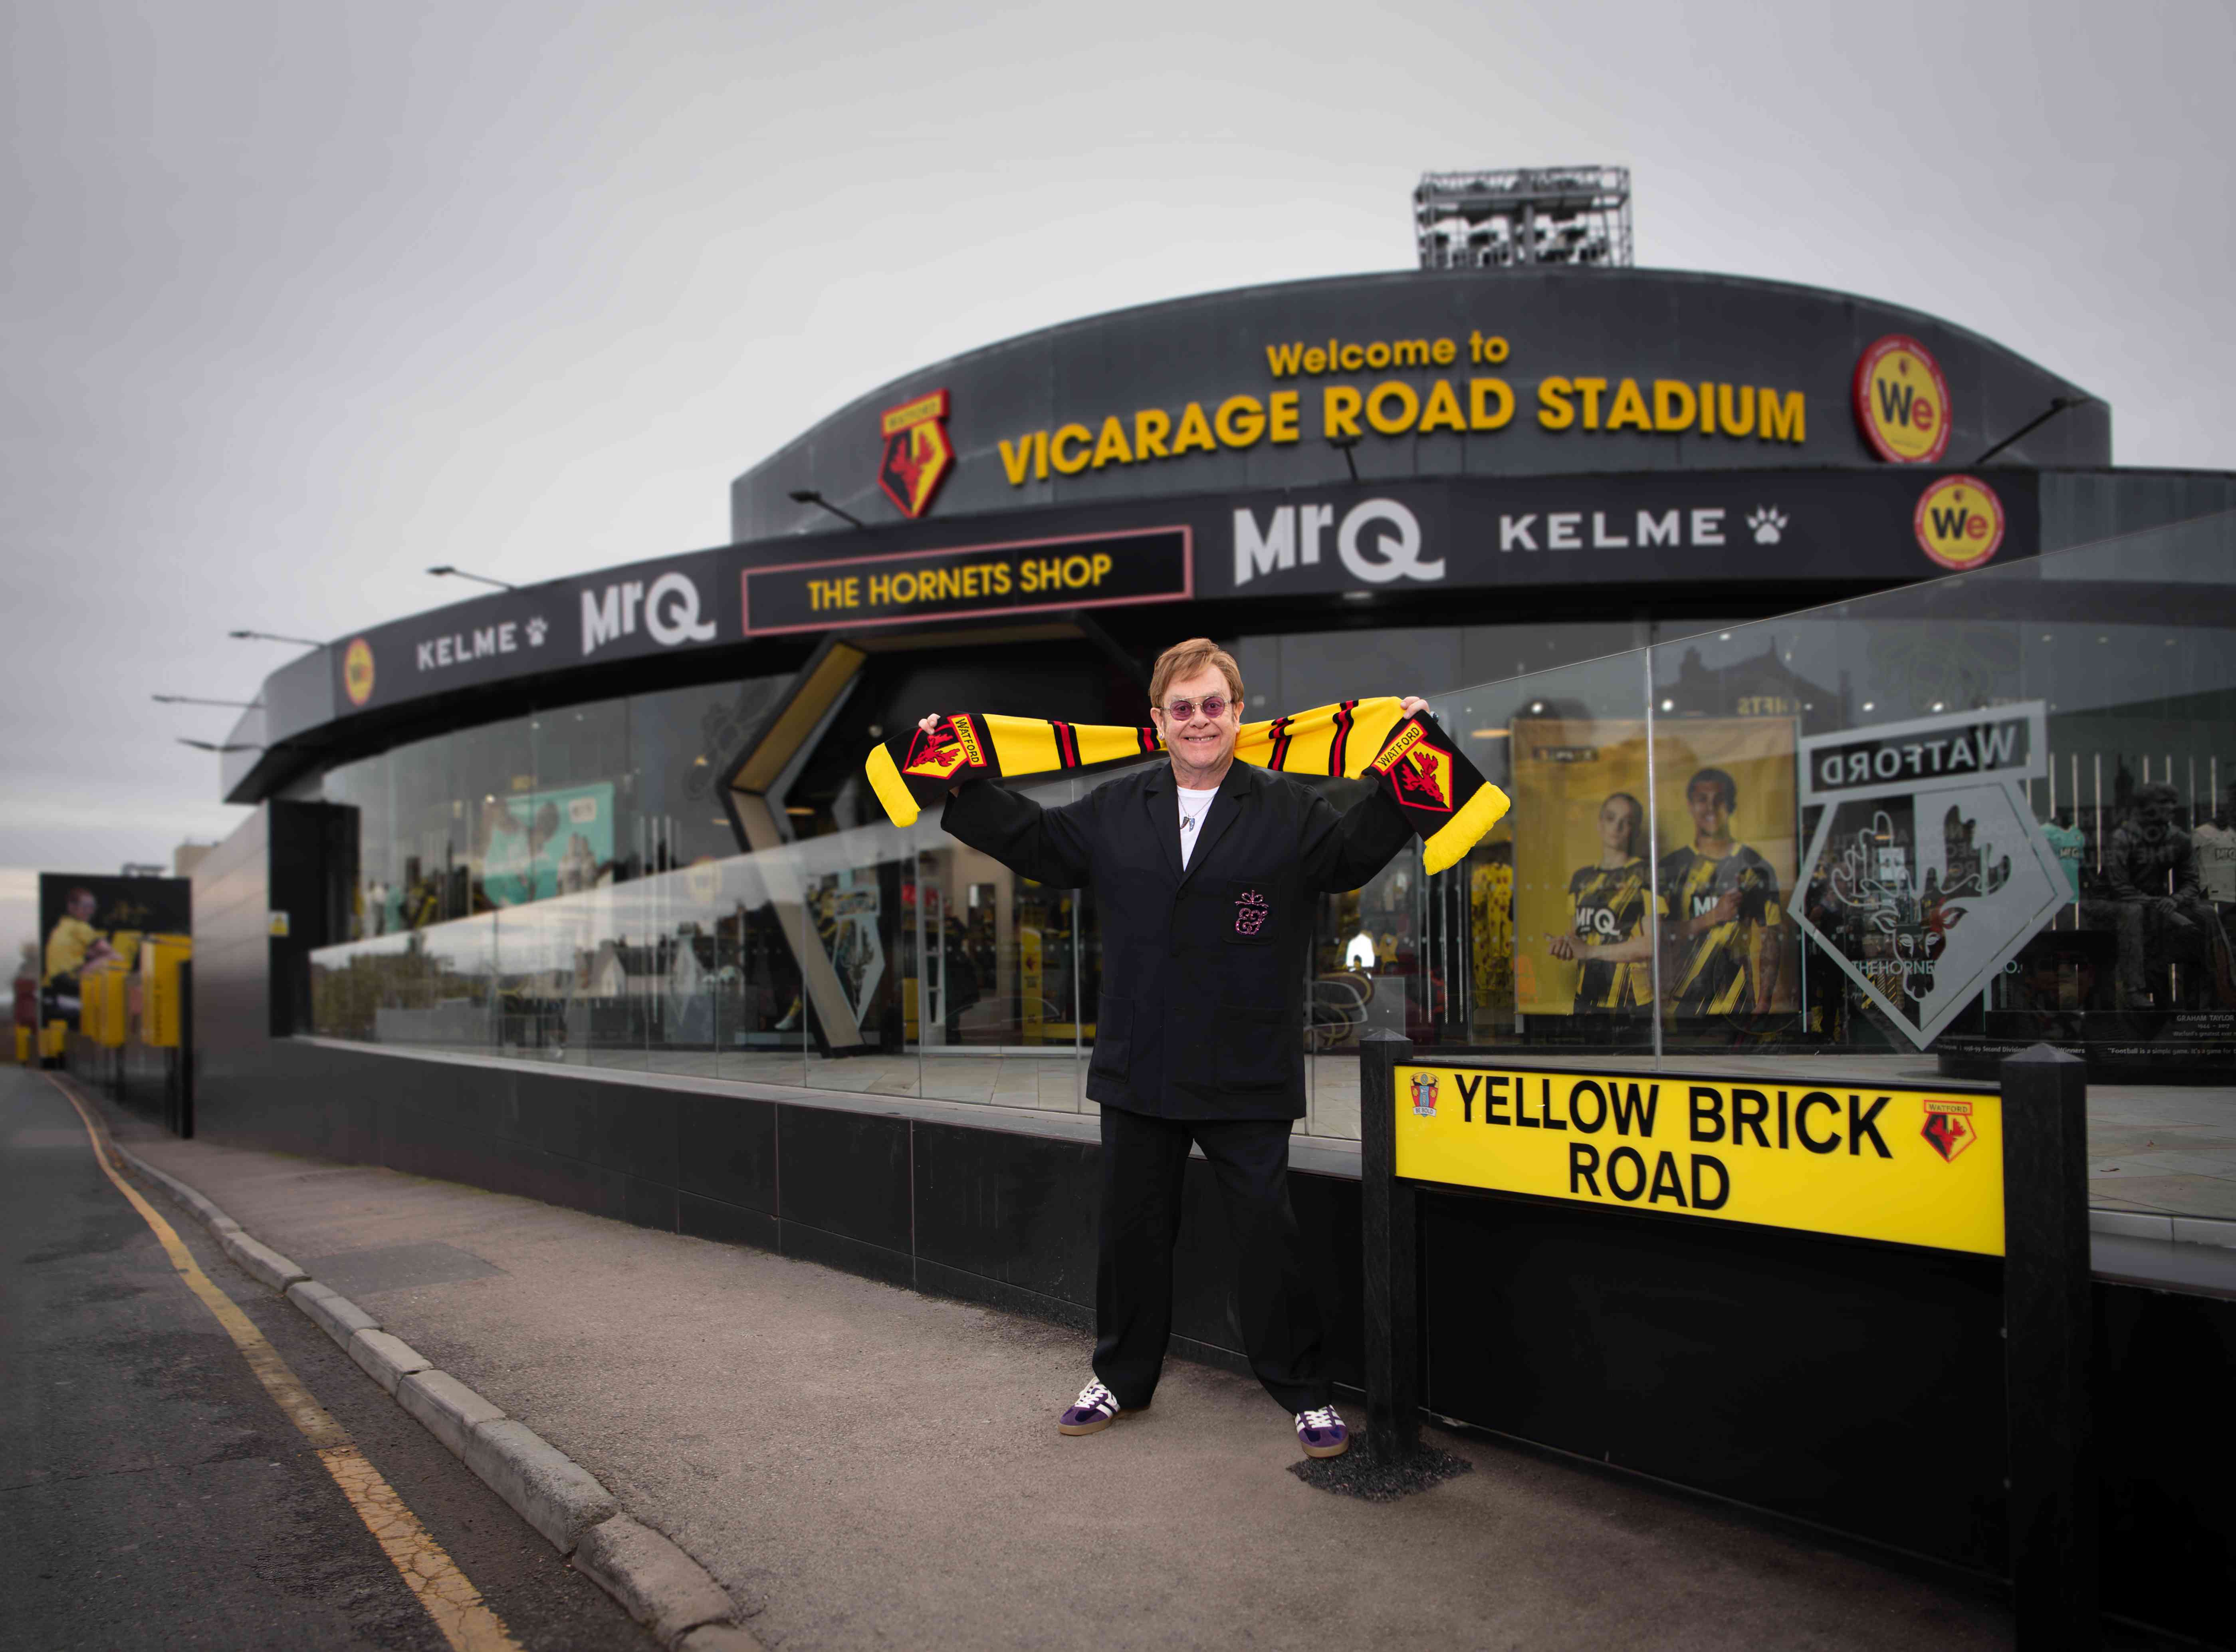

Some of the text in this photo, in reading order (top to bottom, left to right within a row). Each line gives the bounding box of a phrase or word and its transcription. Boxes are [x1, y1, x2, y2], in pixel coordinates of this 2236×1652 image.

[1266, 330, 1509, 377] Welcome to
[1877, 377, 1933, 432] We
[998, 375, 1806, 485] VICARAGE ROAD STADIUM
[1233, 498, 1445, 587] MrQ
[1499, 508, 1725, 551] KELME
[1931, 508, 1988, 540] We
[807, 553, 1112, 611] THE HORNETS SHOP
[581, 571, 716, 656] MrQ
[417, 622, 517, 671] KELME
[955, 718, 979, 762] WATFORD
[1378, 728, 1419, 766] WATFORD
[1576, 907, 1620, 936] MrQ
[1454, 1074, 1893, 1159] YELLOW BRICK
[1929, 1104, 1968, 1113] WATFORD
[1570, 1142, 1730, 1211] ROAD
